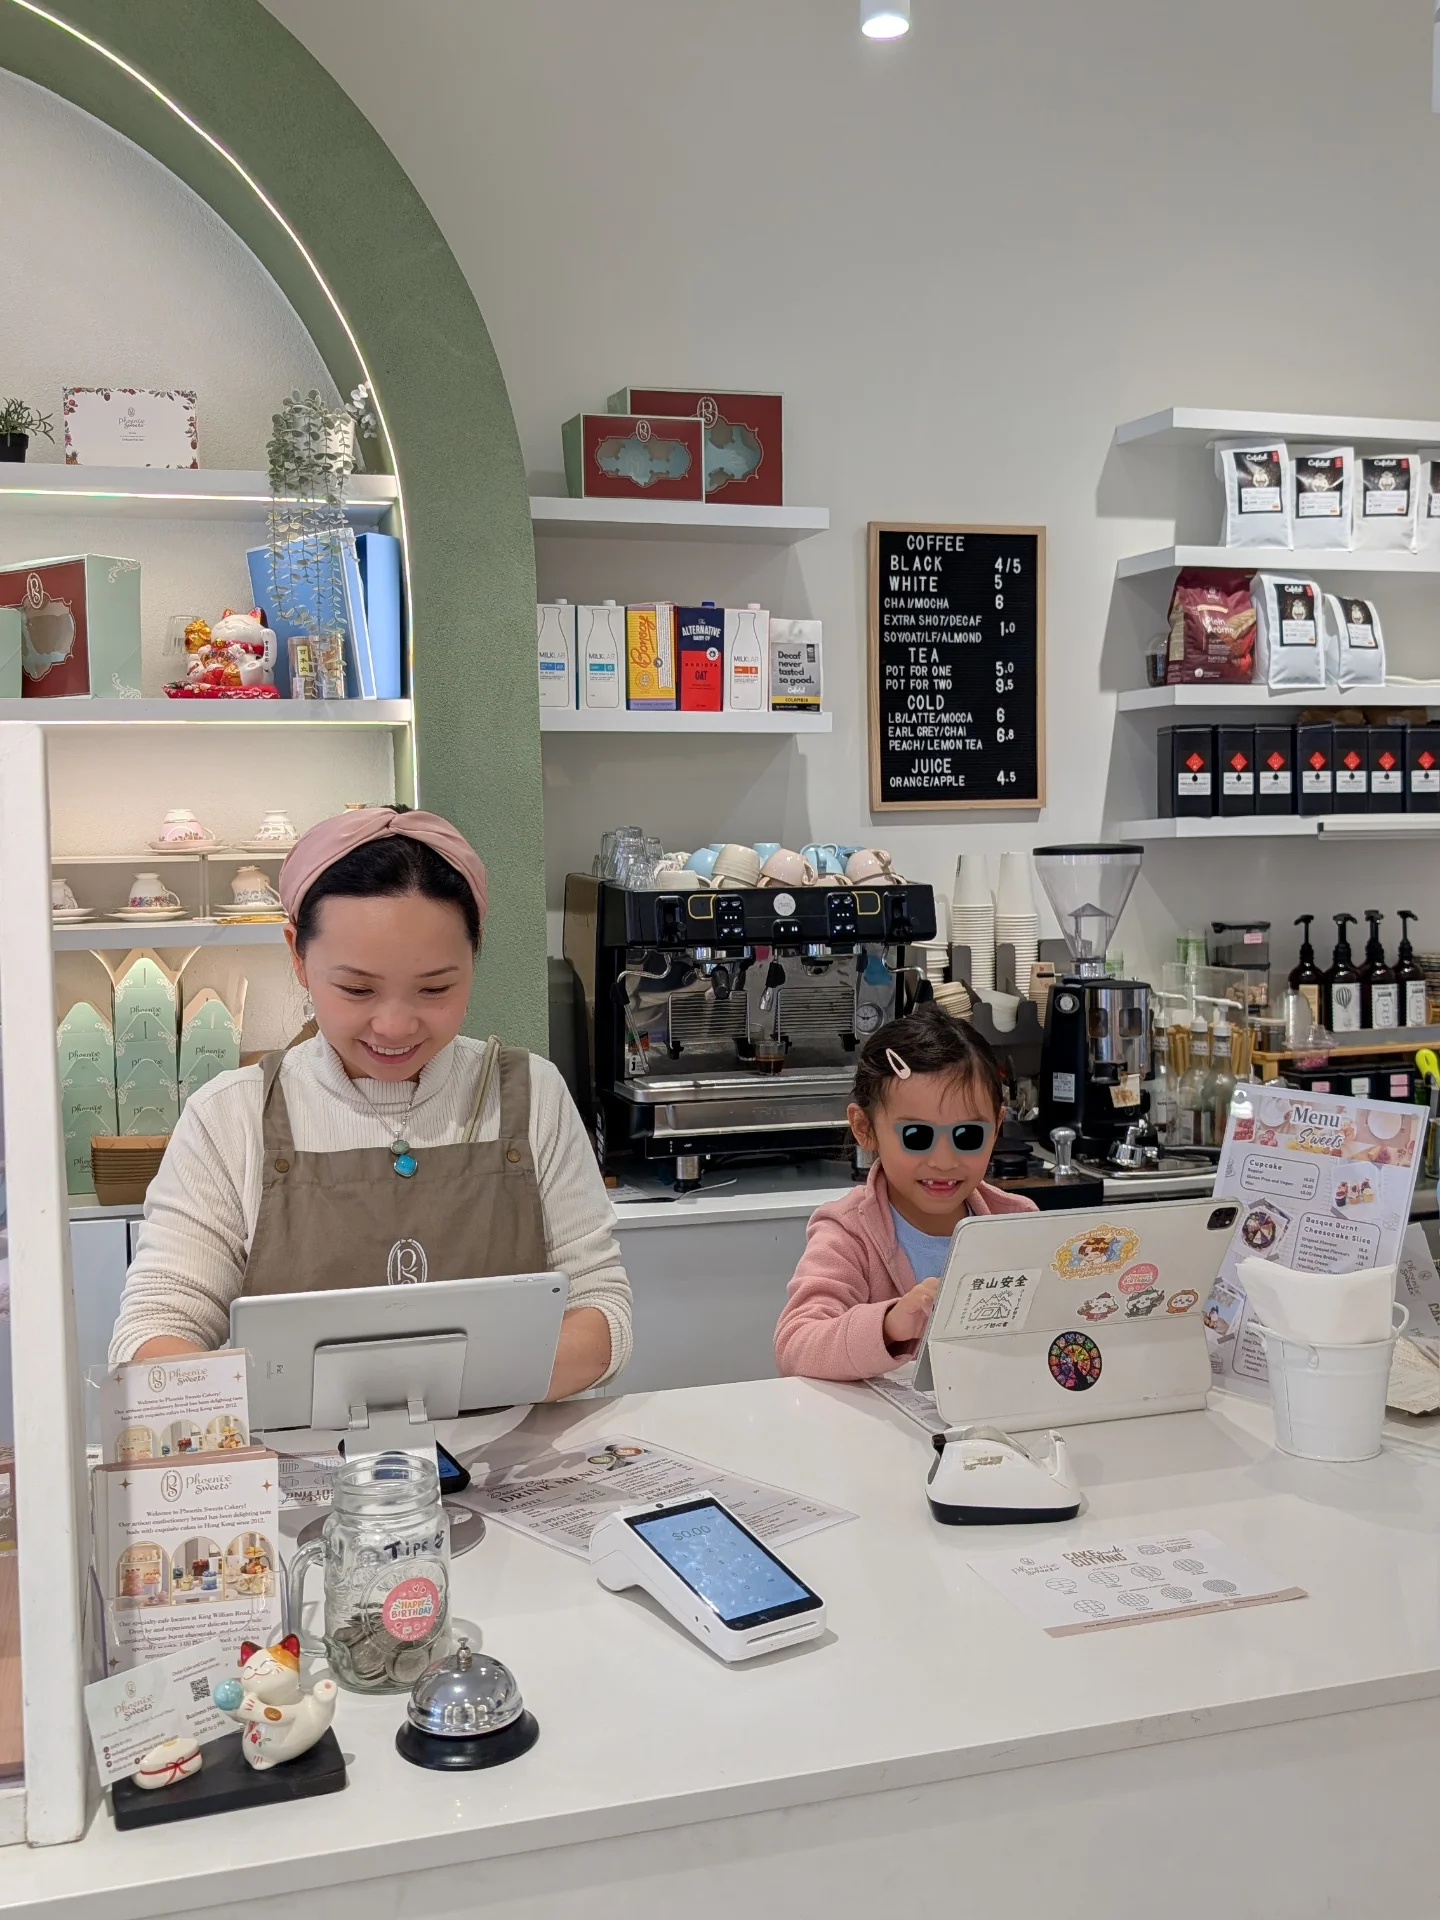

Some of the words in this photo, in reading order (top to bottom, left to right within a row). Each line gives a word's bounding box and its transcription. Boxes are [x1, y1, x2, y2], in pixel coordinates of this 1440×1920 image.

[907, 535, 964, 551] COFFEE
[890, 555, 942, 571] BLACK
[995, 557, 1021, 573] 4/5
[889, 576, 938, 592] WHITE
[995, 574, 1002, 589] 5
[995, 594, 1003, 609] 6
[884, 615, 916, 626] EXTRA
[919, 615, 982, 627] SHOT/DECAF
[682, 625, 721, 637] ALTERNATIVE
[884, 632, 982, 643] SOY/OAT/LF/ALMOND
[778, 651, 801, 659] Decaf
[908, 648, 939, 663] TEA
[695, 671, 708, 680] OAT
[779, 668, 804, 676] tasted
[886, 665, 905, 676] POT
[910, 665, 928, 676] FOR
[932, 665, 952, 676] ONE
[996, 662, 1014, 676] 5.0
[790, 676, 814, 686] good.
[886, 679, 905, 690] POT
[910, 679, 929, 690] FOR
[933, 679, 952, 690] TWO
[996, 678, 1014, 693] 9.5
[907, 695, 945, 710] COLD
[997, 708, 1005, 722] 6
[888, 726, 914, 737] EARL
[917, 726, 966, 737] GREY/CHAI
[997, 728, 1014, 742] 6.8
[965, 739, 983, 750] TEA
[911, 758, 952, 773] JUICE
[890, 775, 965, 787] ORANGE/APPLE
[997, 770, 1016, 785] 4.5
[1292, 1106, 1340, 1129] Menu
[1299, 1127, 1343, 1148] Sweets
[1250, 1160, 1282, 1170] Cupcake
[1306, 1217, 1332, 1227] Basque
[1336, 1222, 1358, 1231] Burnt
[1304, 1227, 1348, 1240] Cheesecake
[1352, 1236, 1370, 1244] Slice
[971, 1274, 1028, 1291] 登山安全
[499, 1483, 558, 1503] DRINK
[554, 1468, 605, 1486] MENU
[671, 1525, 711, 1541] $0.00
[384, 1540, 429, 1560] Tips
[1062, 1549, 1095, 1560] CAKE
[1071, 1552, 1127, 1567] CUTTING
[391, 1606, 432, 1618] BIRTHDAY
[401, 1600, 425, 1609] HAPPY
